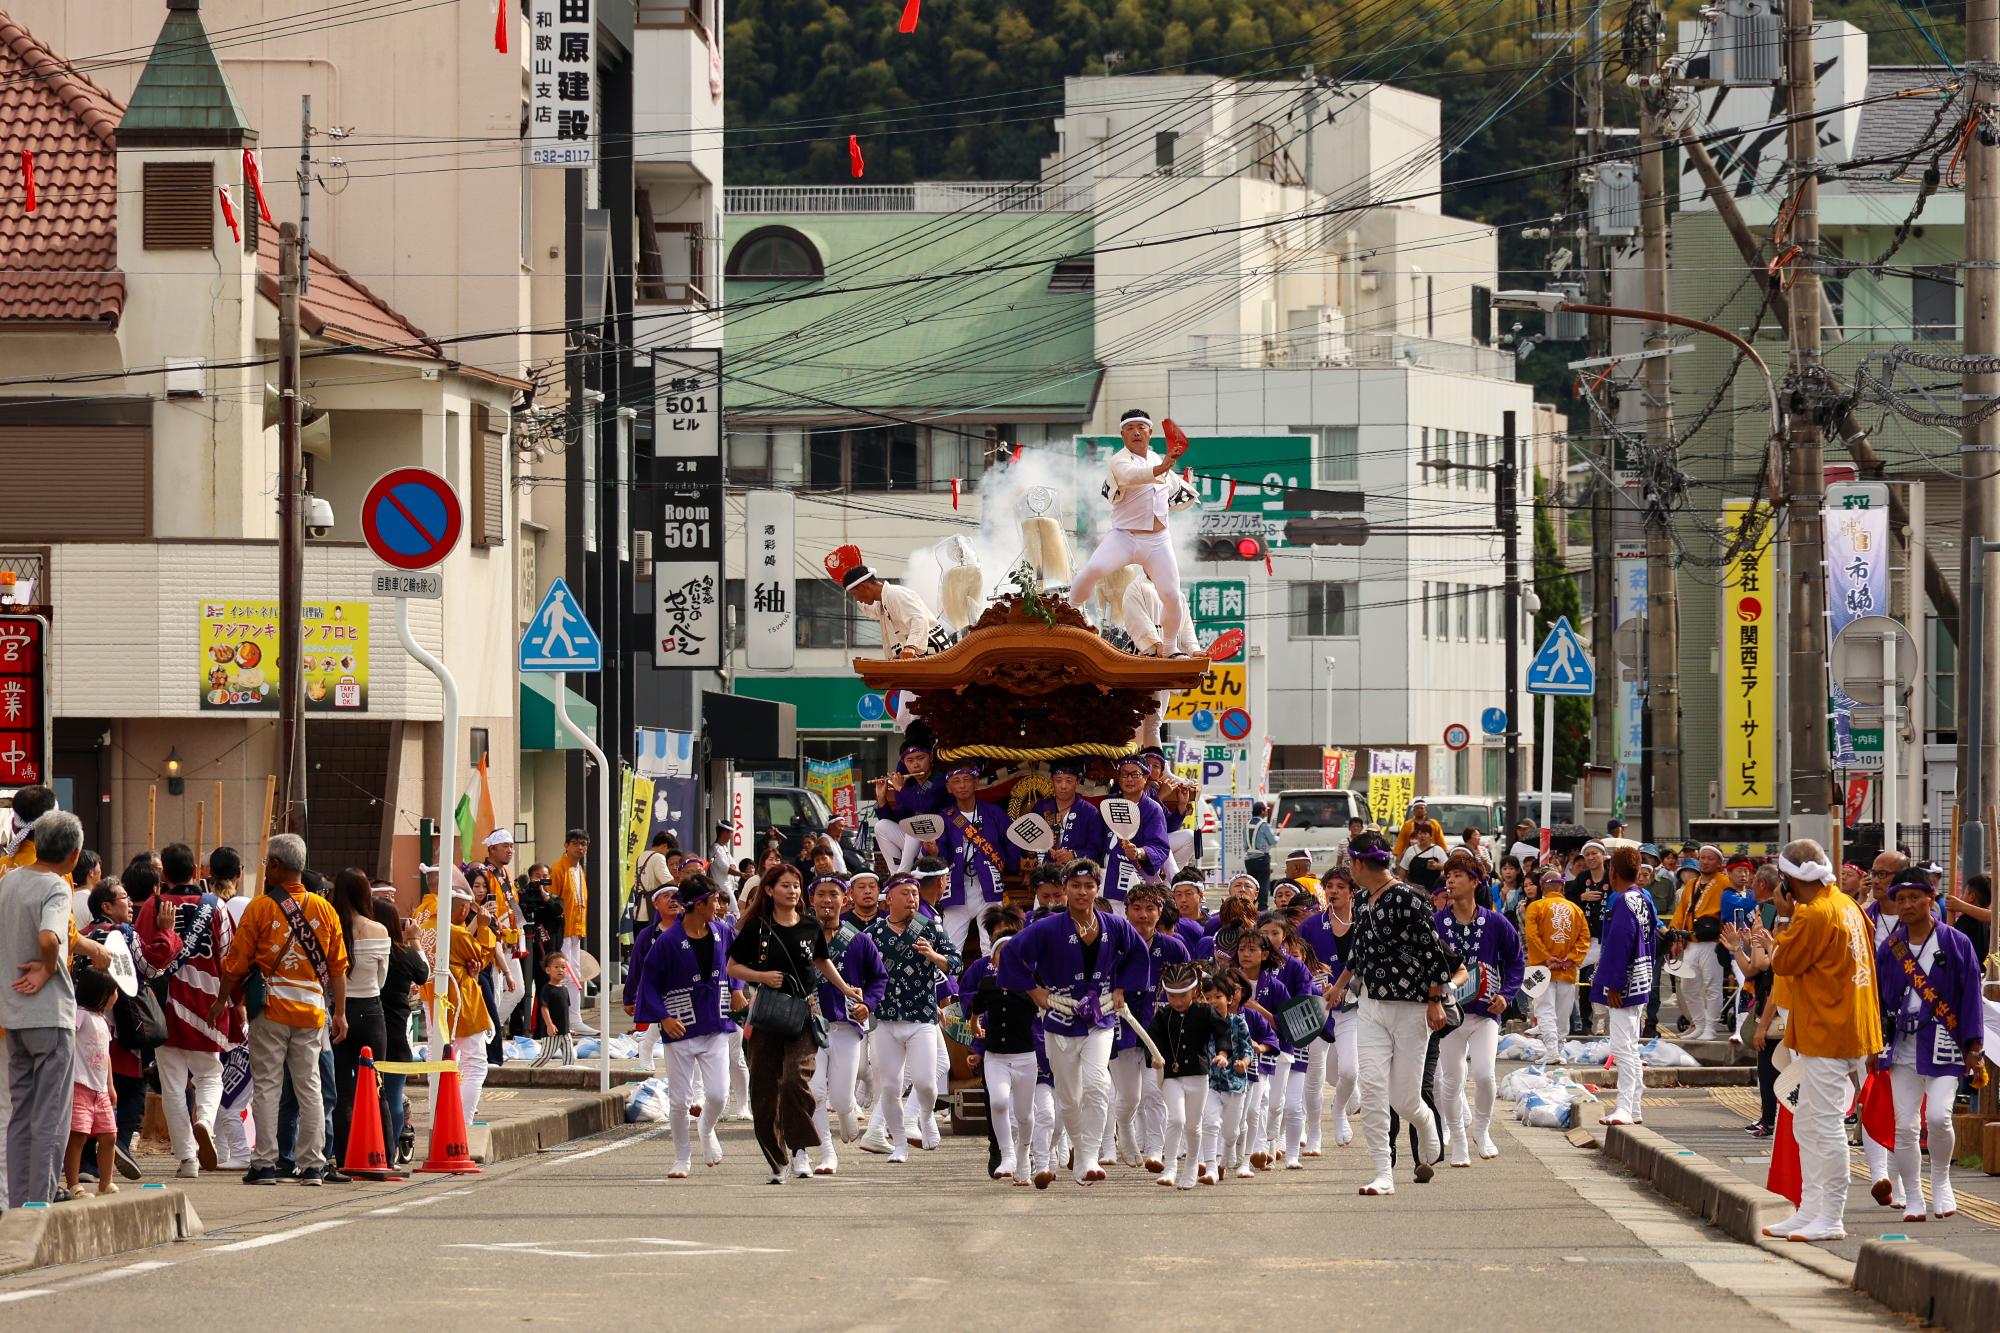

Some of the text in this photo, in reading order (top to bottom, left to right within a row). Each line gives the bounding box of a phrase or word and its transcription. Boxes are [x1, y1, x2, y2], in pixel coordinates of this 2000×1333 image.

[535, 11, 552, 123] 和歌山支店
[666, 396, 708, 414] 501
[673, 418, 700, 431] ビル
[665, 504, 710, 520] Room
[665, 523, 711, 549] 501
[377, 576, 438, 594] 自動車(2輪を除く)
[754, 581, 785, 613] 紬
[1198, 587, 1243, 616] 精肉
[664, 589, 706, 656] やすべえ
[768, 609, 792, 634] TSUMUGI
[0, 624, 32, 775] 営業中
[339, 685, 356, 693] TAKE
[1740, 625, 1760, 797] 関西エアーサービス
[1449, 730, 1463, 744] 30
[1203, 747, 1233, 759] 21:5
[1203, 761, 1224, 785] P
[733, 792, 742, 847] DyDo
[1903, 959, 1958, 1031] 安全責任者
